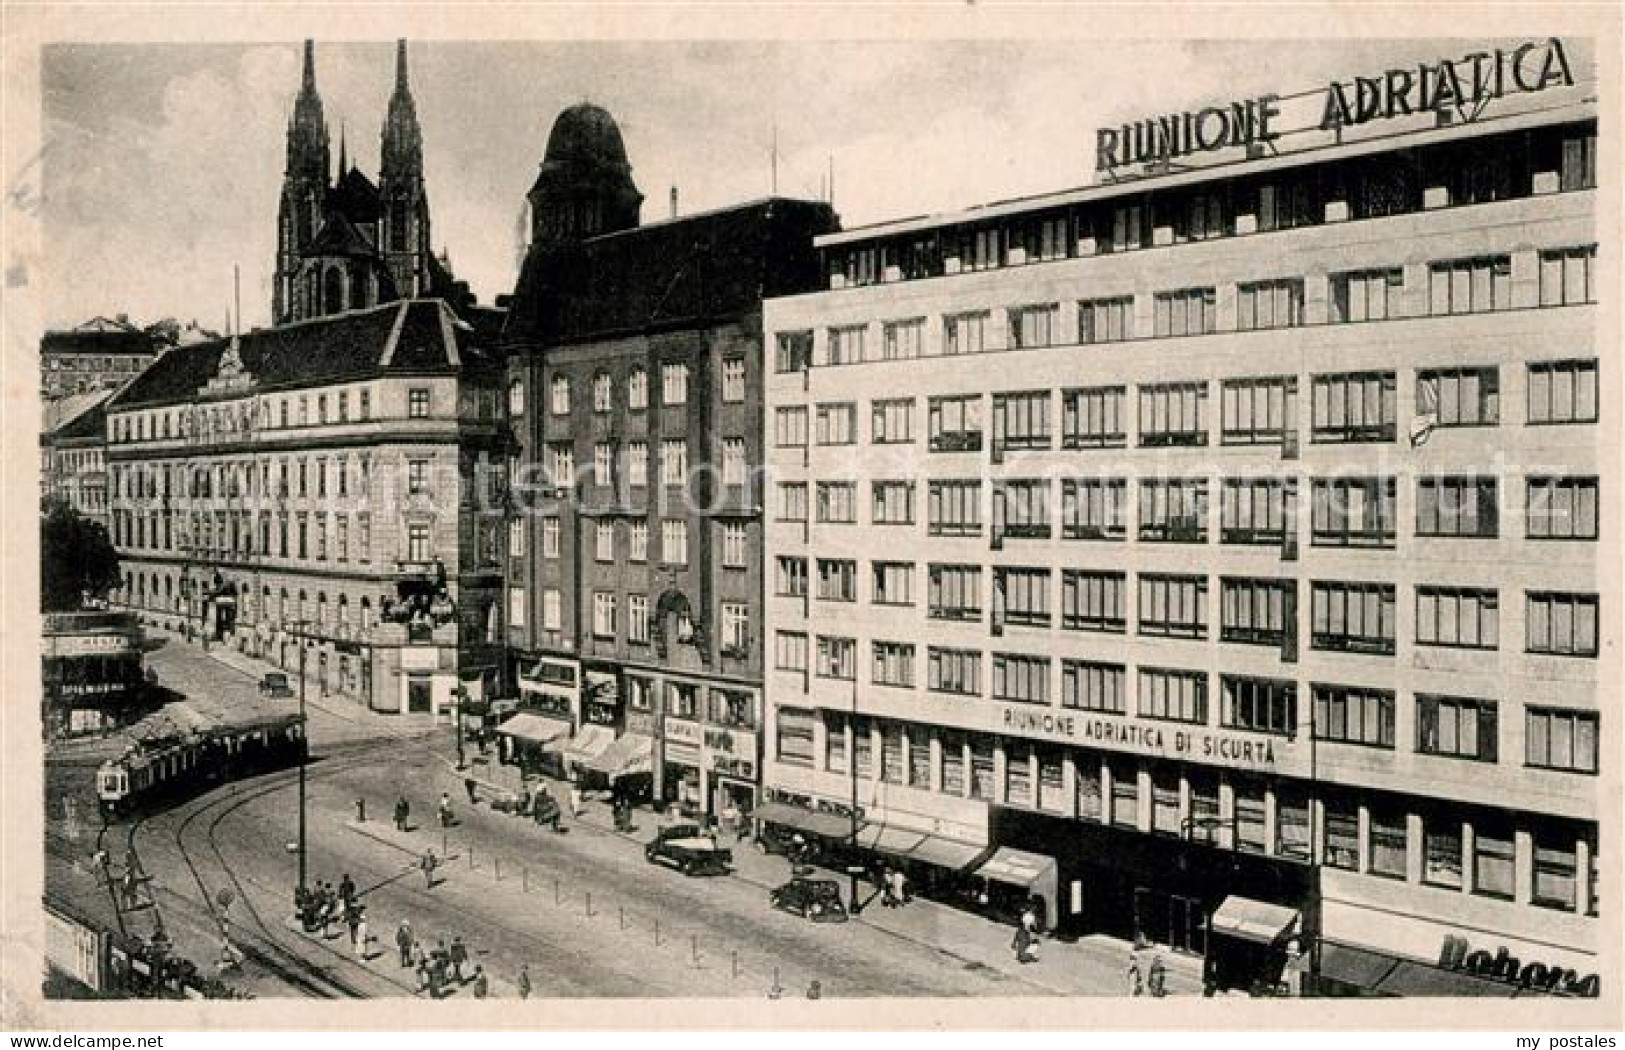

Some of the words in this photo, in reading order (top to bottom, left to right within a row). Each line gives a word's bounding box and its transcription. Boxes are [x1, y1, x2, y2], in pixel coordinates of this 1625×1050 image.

[1094, 94, 1280, 172] RIUNIONE
[1320, 37, 1574, 130] ADRIATICA
[1003, 708, 1075, 737] RIUNIONE
[1085, 719, 1163, 747] ADRIATICA
[1175, 731, 1191, 752] DI
